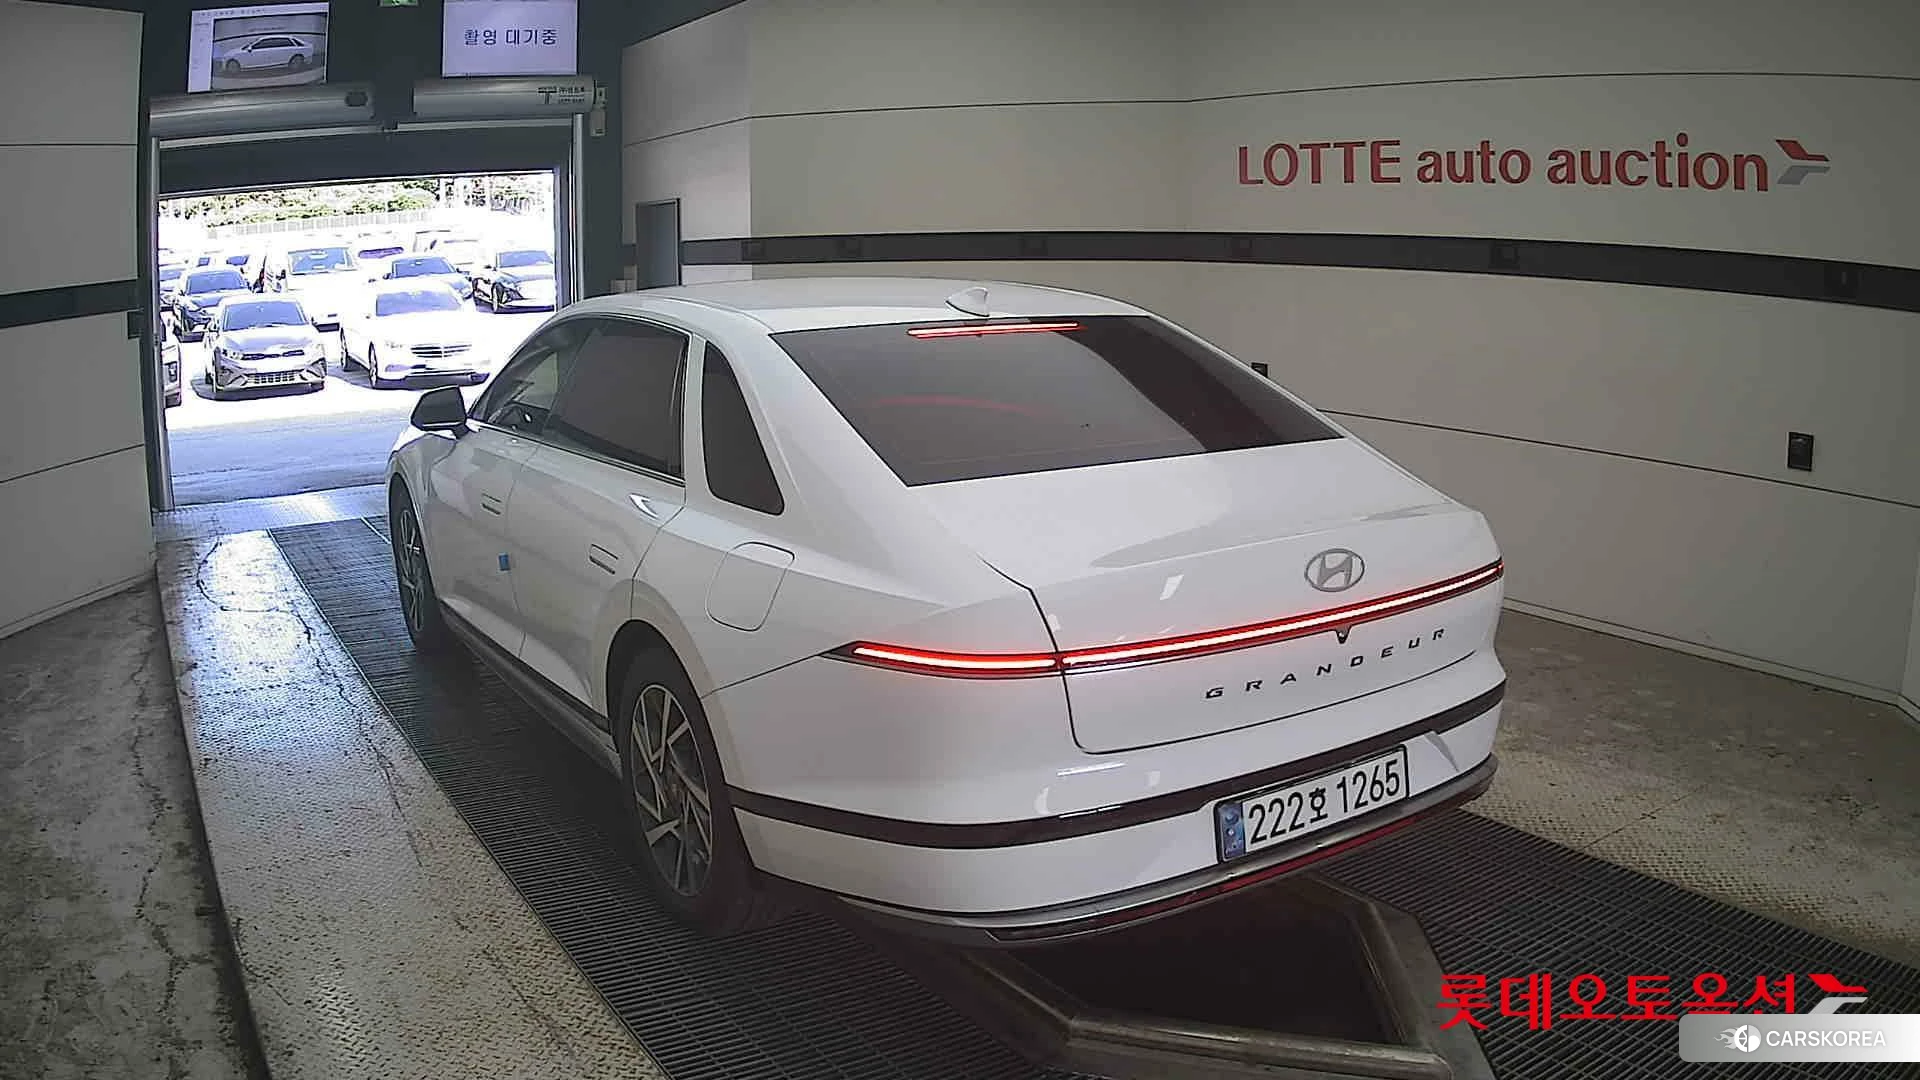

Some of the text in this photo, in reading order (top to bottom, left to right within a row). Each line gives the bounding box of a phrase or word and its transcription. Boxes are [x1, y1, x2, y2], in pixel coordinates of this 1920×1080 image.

[504, 29, 558, 46] 대기중
[1238, 132, 1769, 191] LOTTE auto auction
[1205, 628, 1445, 700] GRANDEUR
[1336, 758, 1400, 814] 1265
